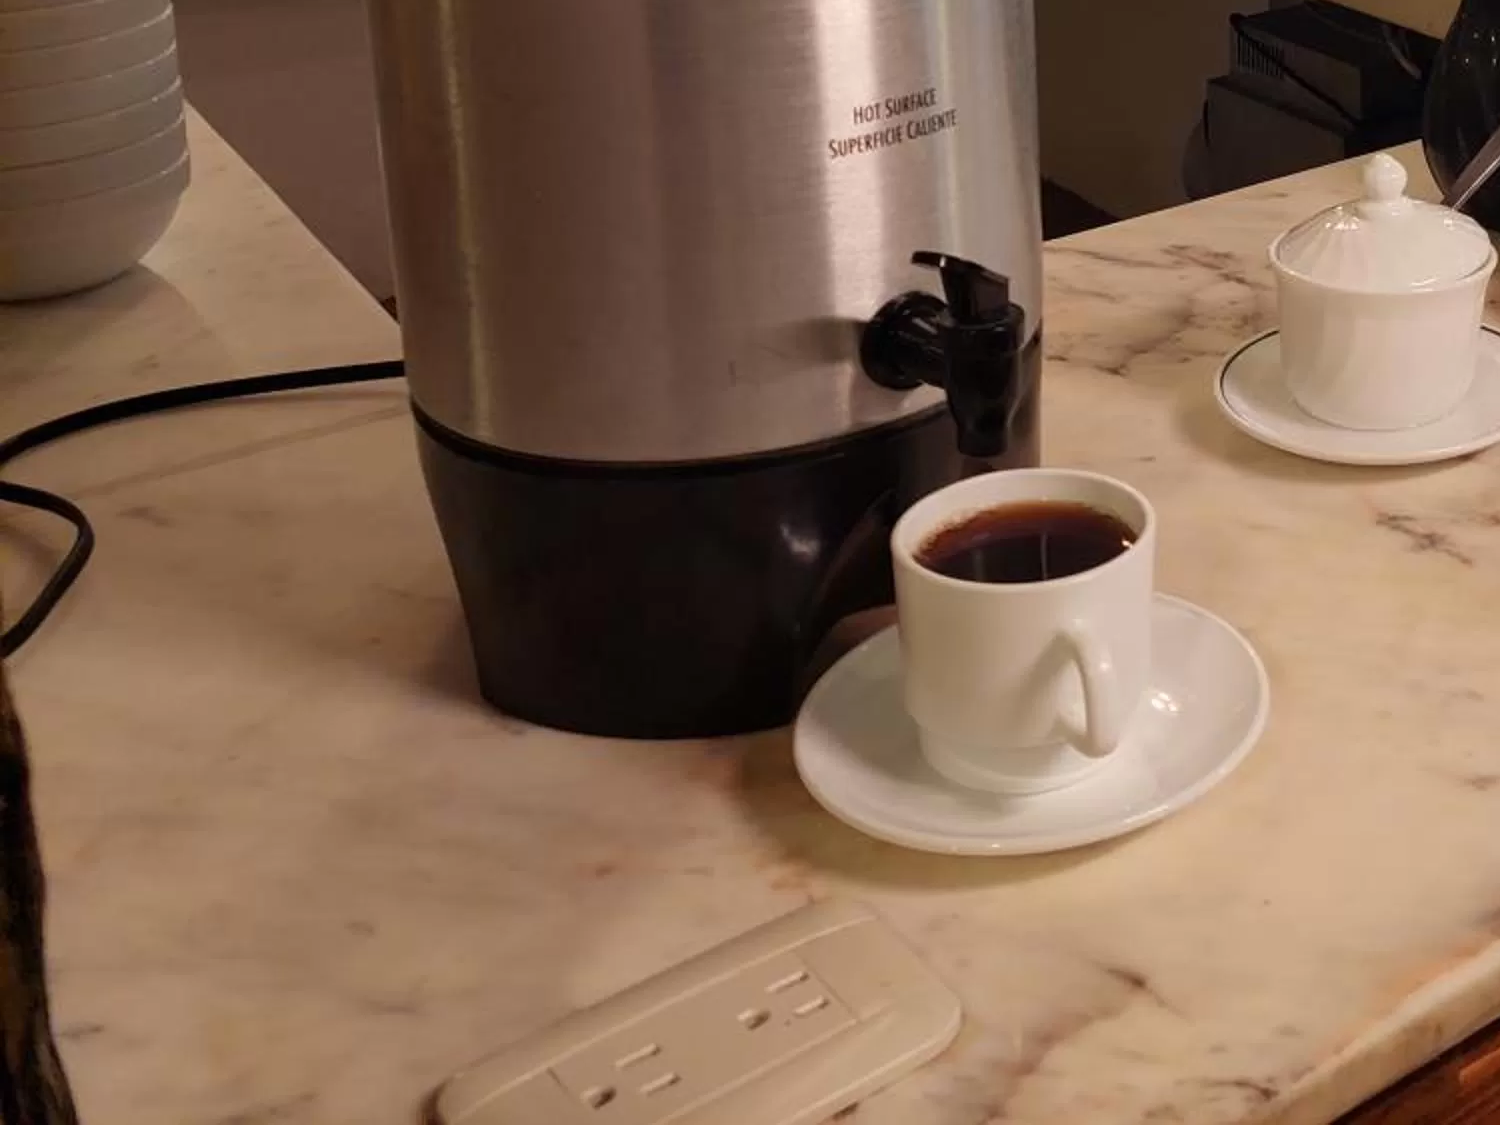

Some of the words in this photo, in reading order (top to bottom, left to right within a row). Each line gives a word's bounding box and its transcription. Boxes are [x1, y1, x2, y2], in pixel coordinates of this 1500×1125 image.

[853, 102, 881, 125] HOT
[885, 87, 937, 119] SURFACE
[828, 123, 902, 159] SUPERFICIE
[906, 108, 956, 139] CALIENTE
